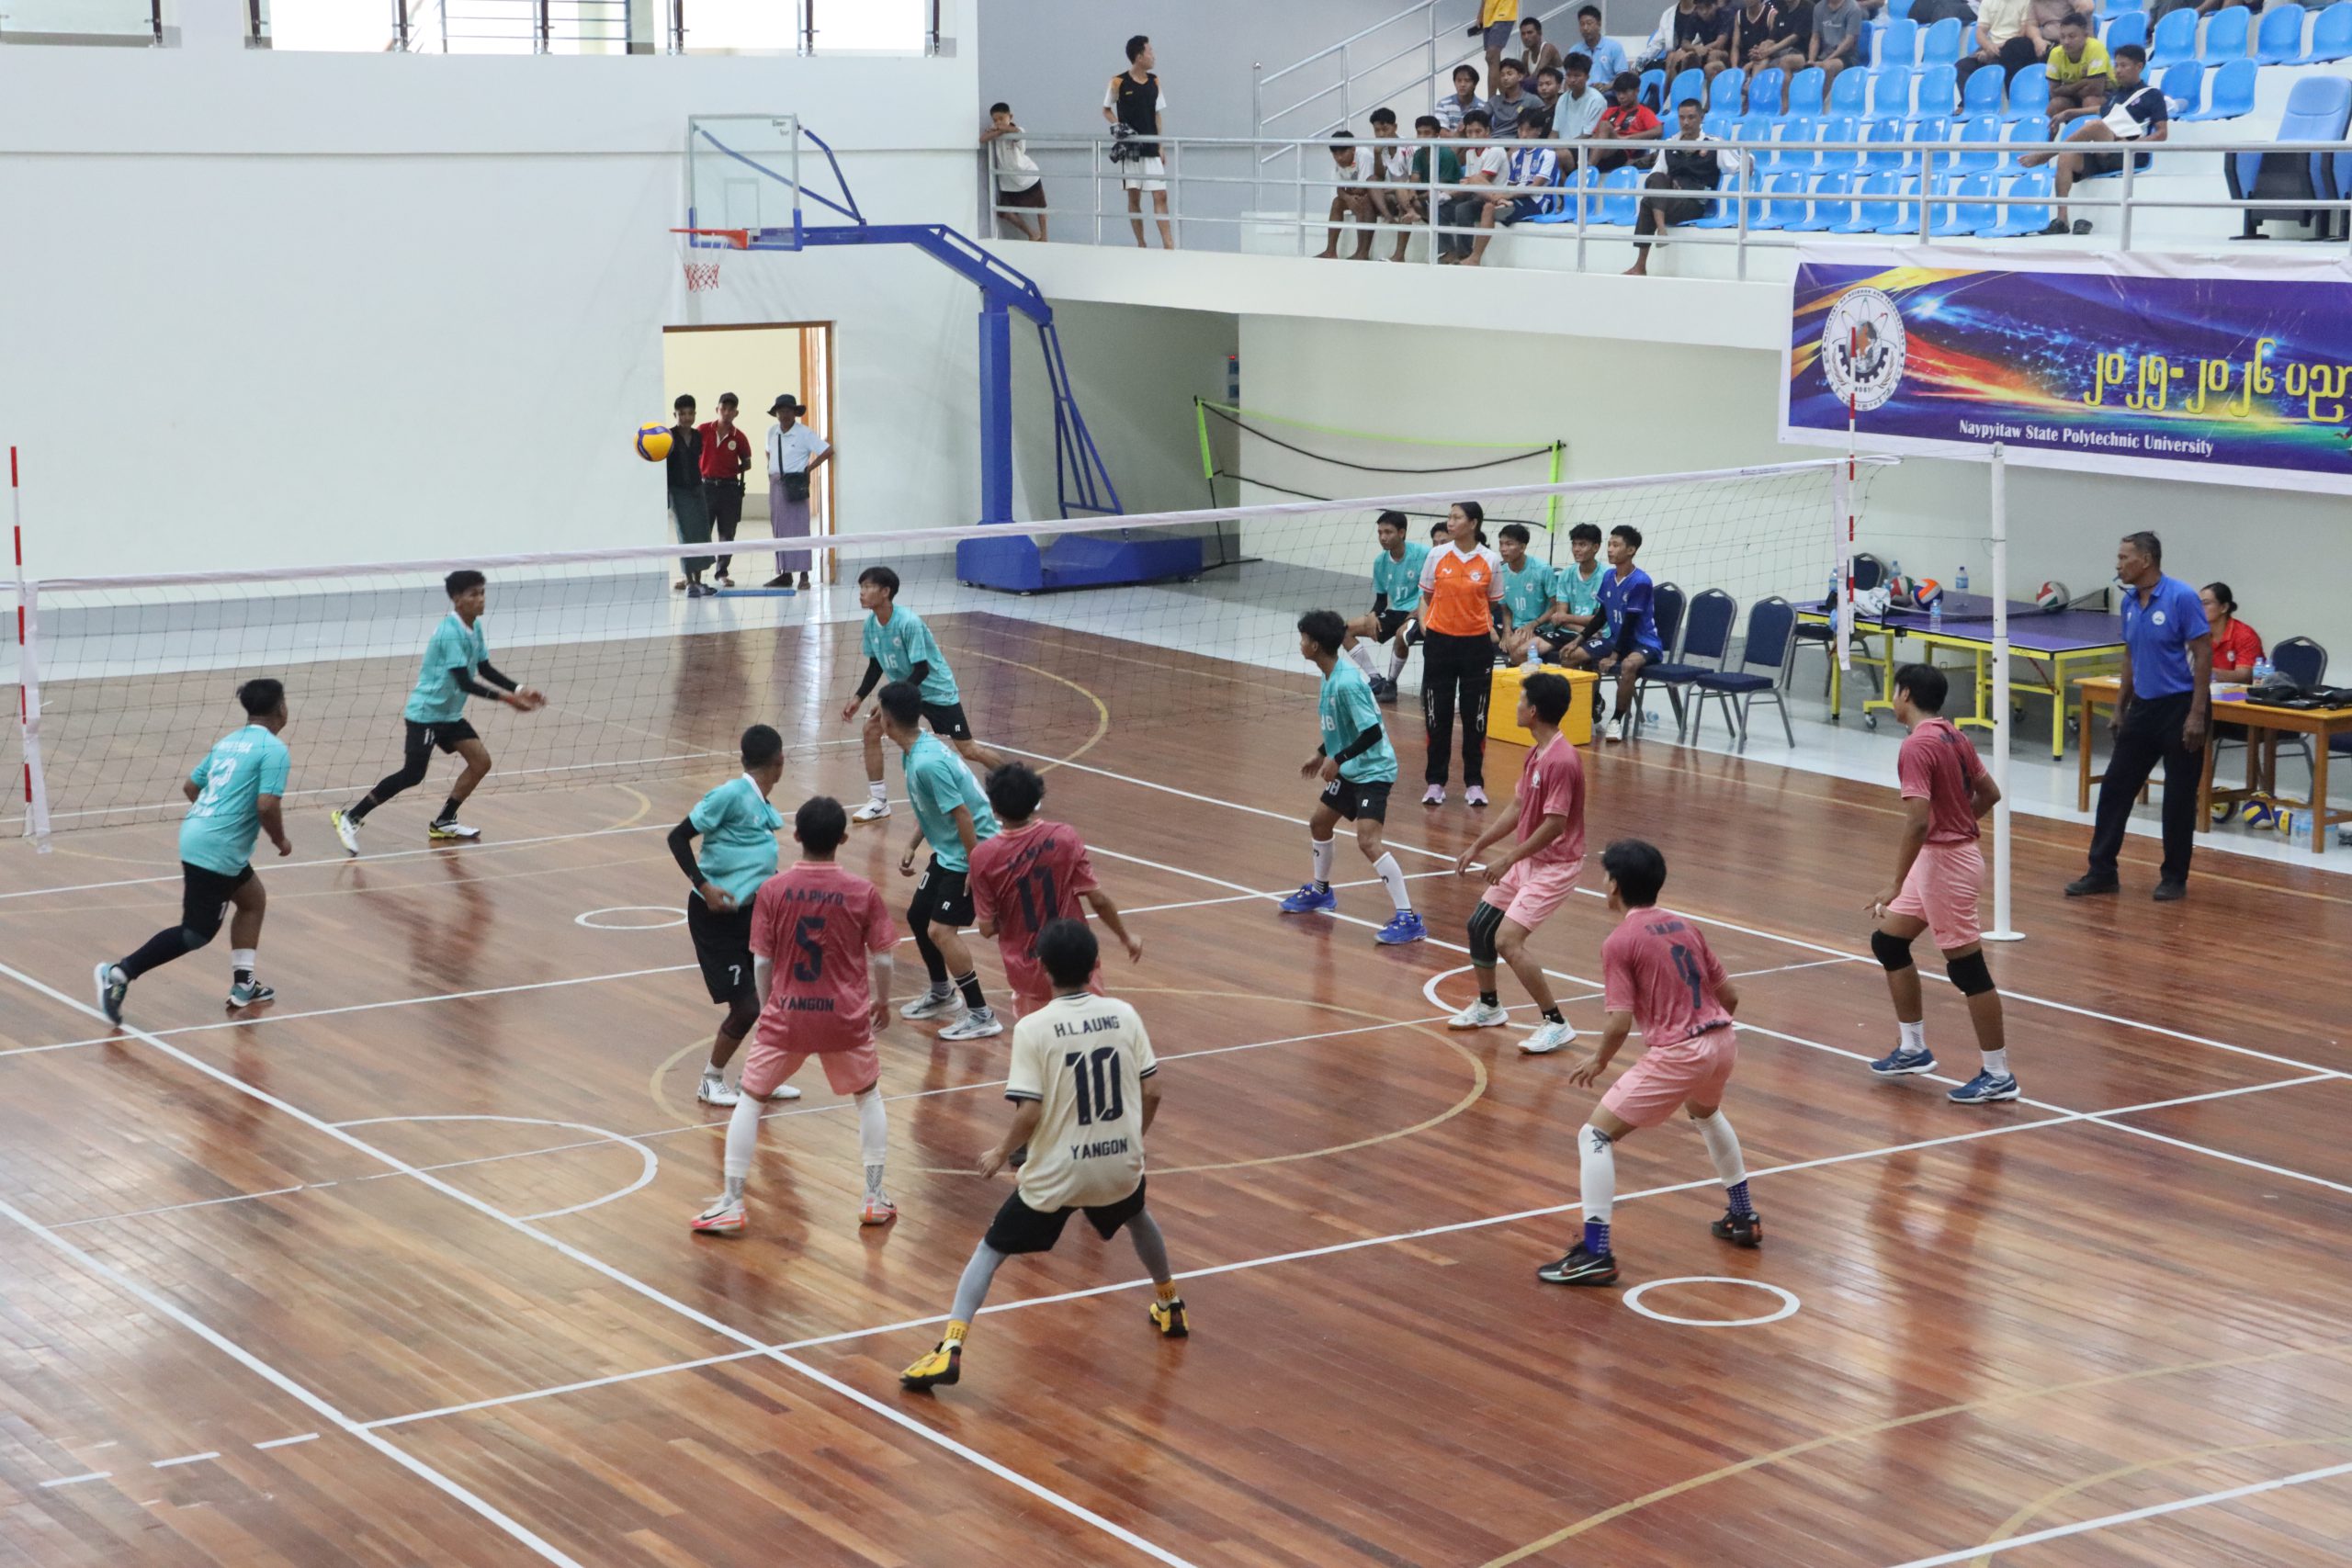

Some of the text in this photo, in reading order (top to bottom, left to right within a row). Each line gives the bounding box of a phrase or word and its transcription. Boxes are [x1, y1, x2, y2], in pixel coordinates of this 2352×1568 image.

[1959, 419, 2213, 457] Naypyitaw State Polytechnic University
[1515, 597, 1526, 611] 10
[883, 653, 899, 670] 16
[794, 916, 825, 982] 5
[728, 964, 741, 986] 7
[780, 997, 835, 1011] YANGON
[1054, 1015, 1120, 1038] H.L.AUNG
[1066, 1046, 1124, 1126] 10
[1070, 1138, 1128, 1160] YANGON
